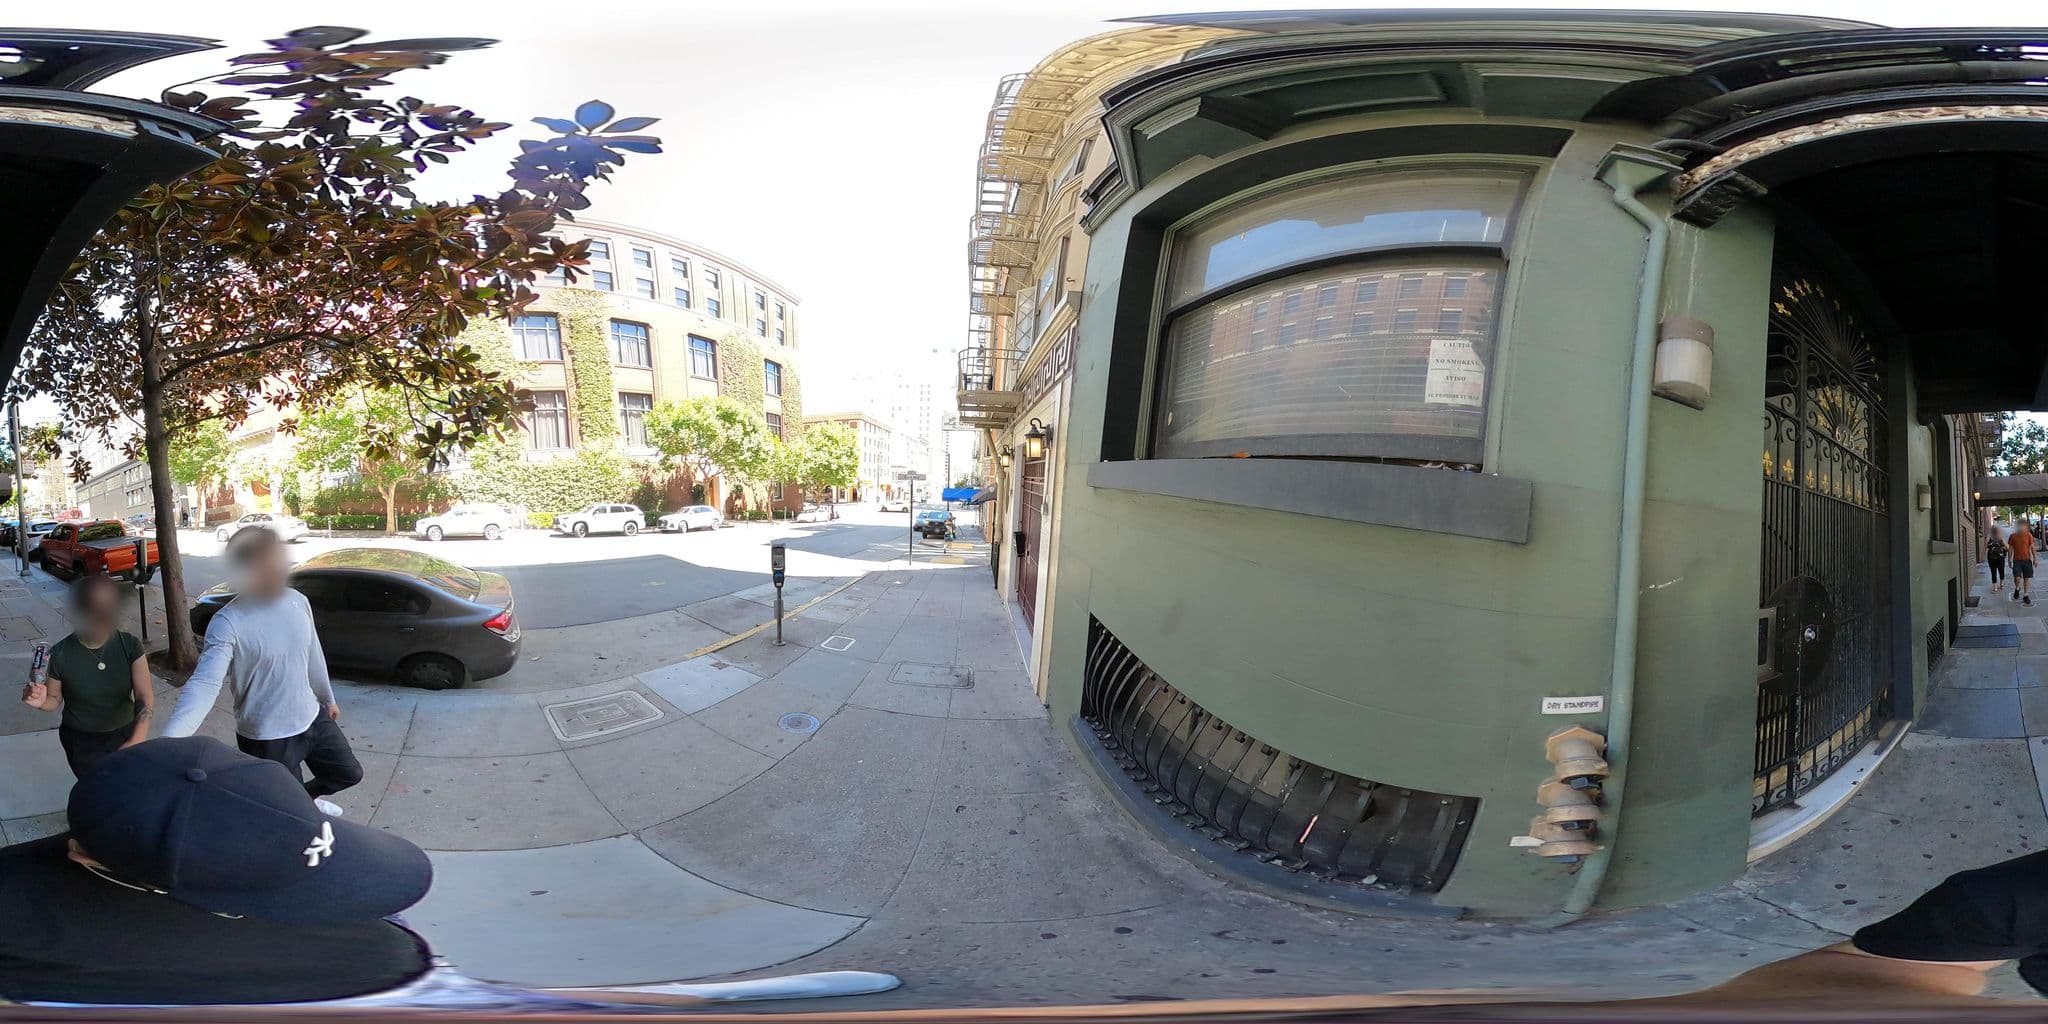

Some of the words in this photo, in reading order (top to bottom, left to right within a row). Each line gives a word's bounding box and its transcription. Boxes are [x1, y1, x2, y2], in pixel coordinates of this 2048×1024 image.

[1446, 358, 1480, 366] SMOKING
[1835, 426, 1855, 450] 625
[1547, 702, 1561, 710] DRY
